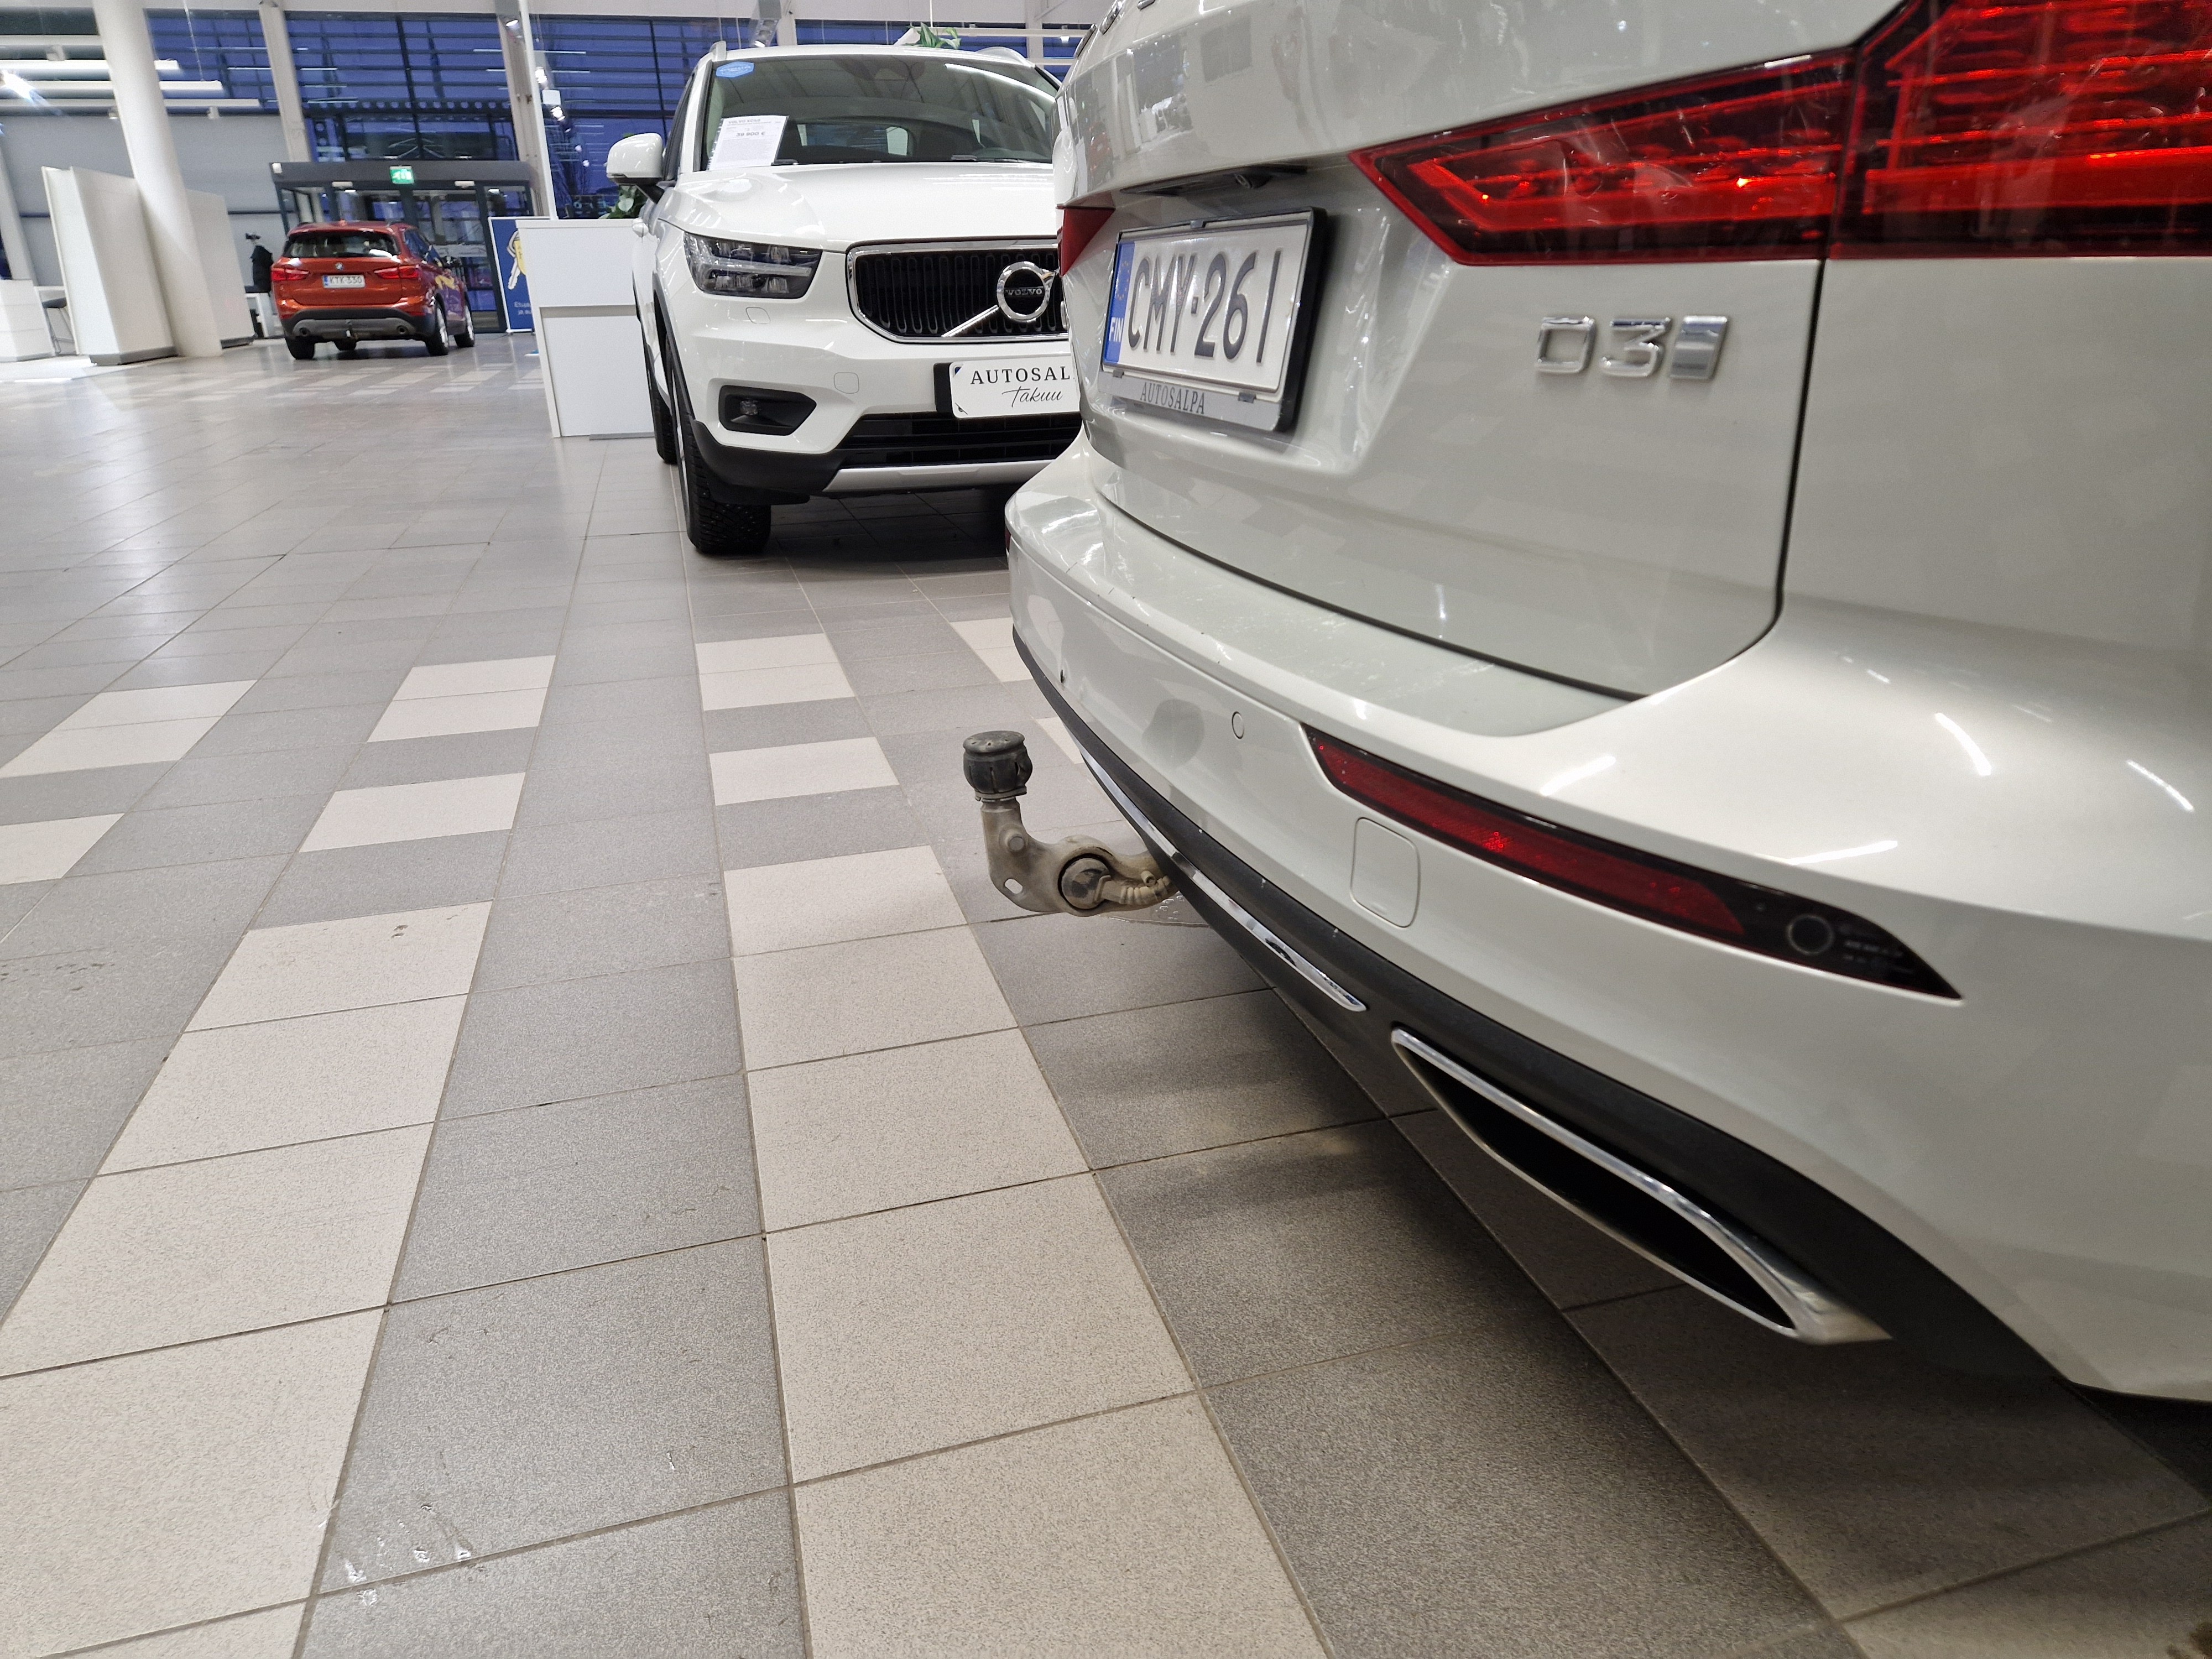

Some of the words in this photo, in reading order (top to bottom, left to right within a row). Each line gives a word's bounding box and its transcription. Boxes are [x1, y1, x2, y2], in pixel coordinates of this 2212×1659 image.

[1005, 288, 1043, 296] VOLVO
[1129, 250, 1282, 364] CMY-261
[1109, 317, 1124, 342] FIN
[971, 366, 1075, 384] AUTOSAL
[1001, 385, 1063, 408] Takuu
[1140, 382, 1206, 415] AUTOSALPA
